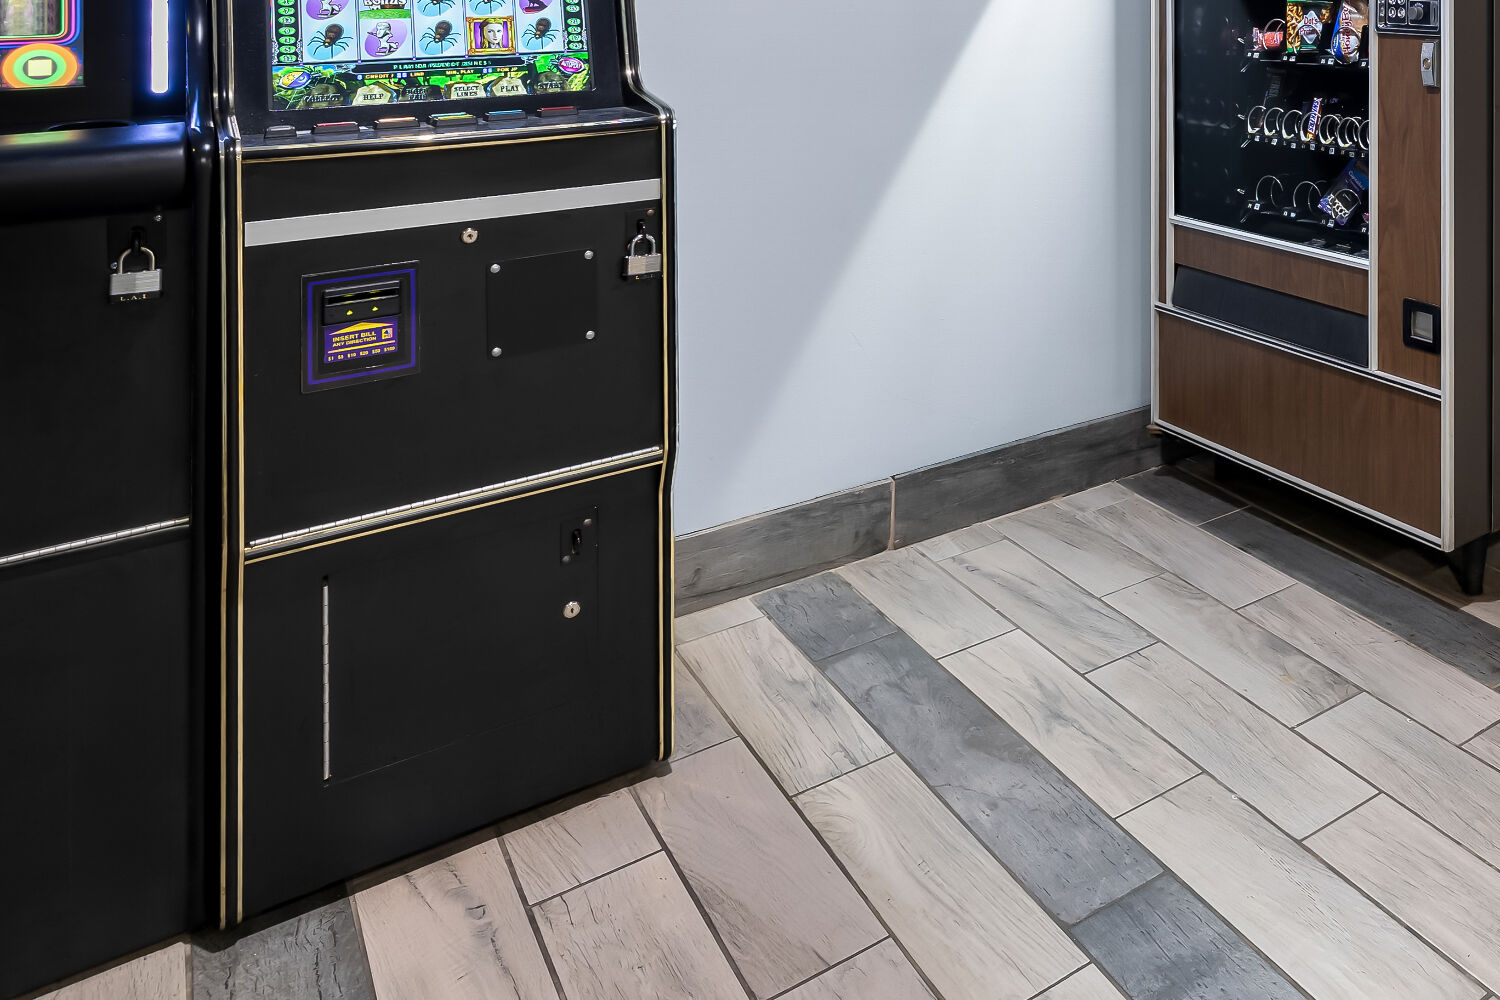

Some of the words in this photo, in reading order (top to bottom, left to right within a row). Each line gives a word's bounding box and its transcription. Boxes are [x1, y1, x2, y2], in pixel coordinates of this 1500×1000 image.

[363, 93, 384, 101] HELP
[500, 84, 520, 93] PLAY
[333, 334, 359, 342] INSERT
[346, 337, 376, 345] DIRECTION
